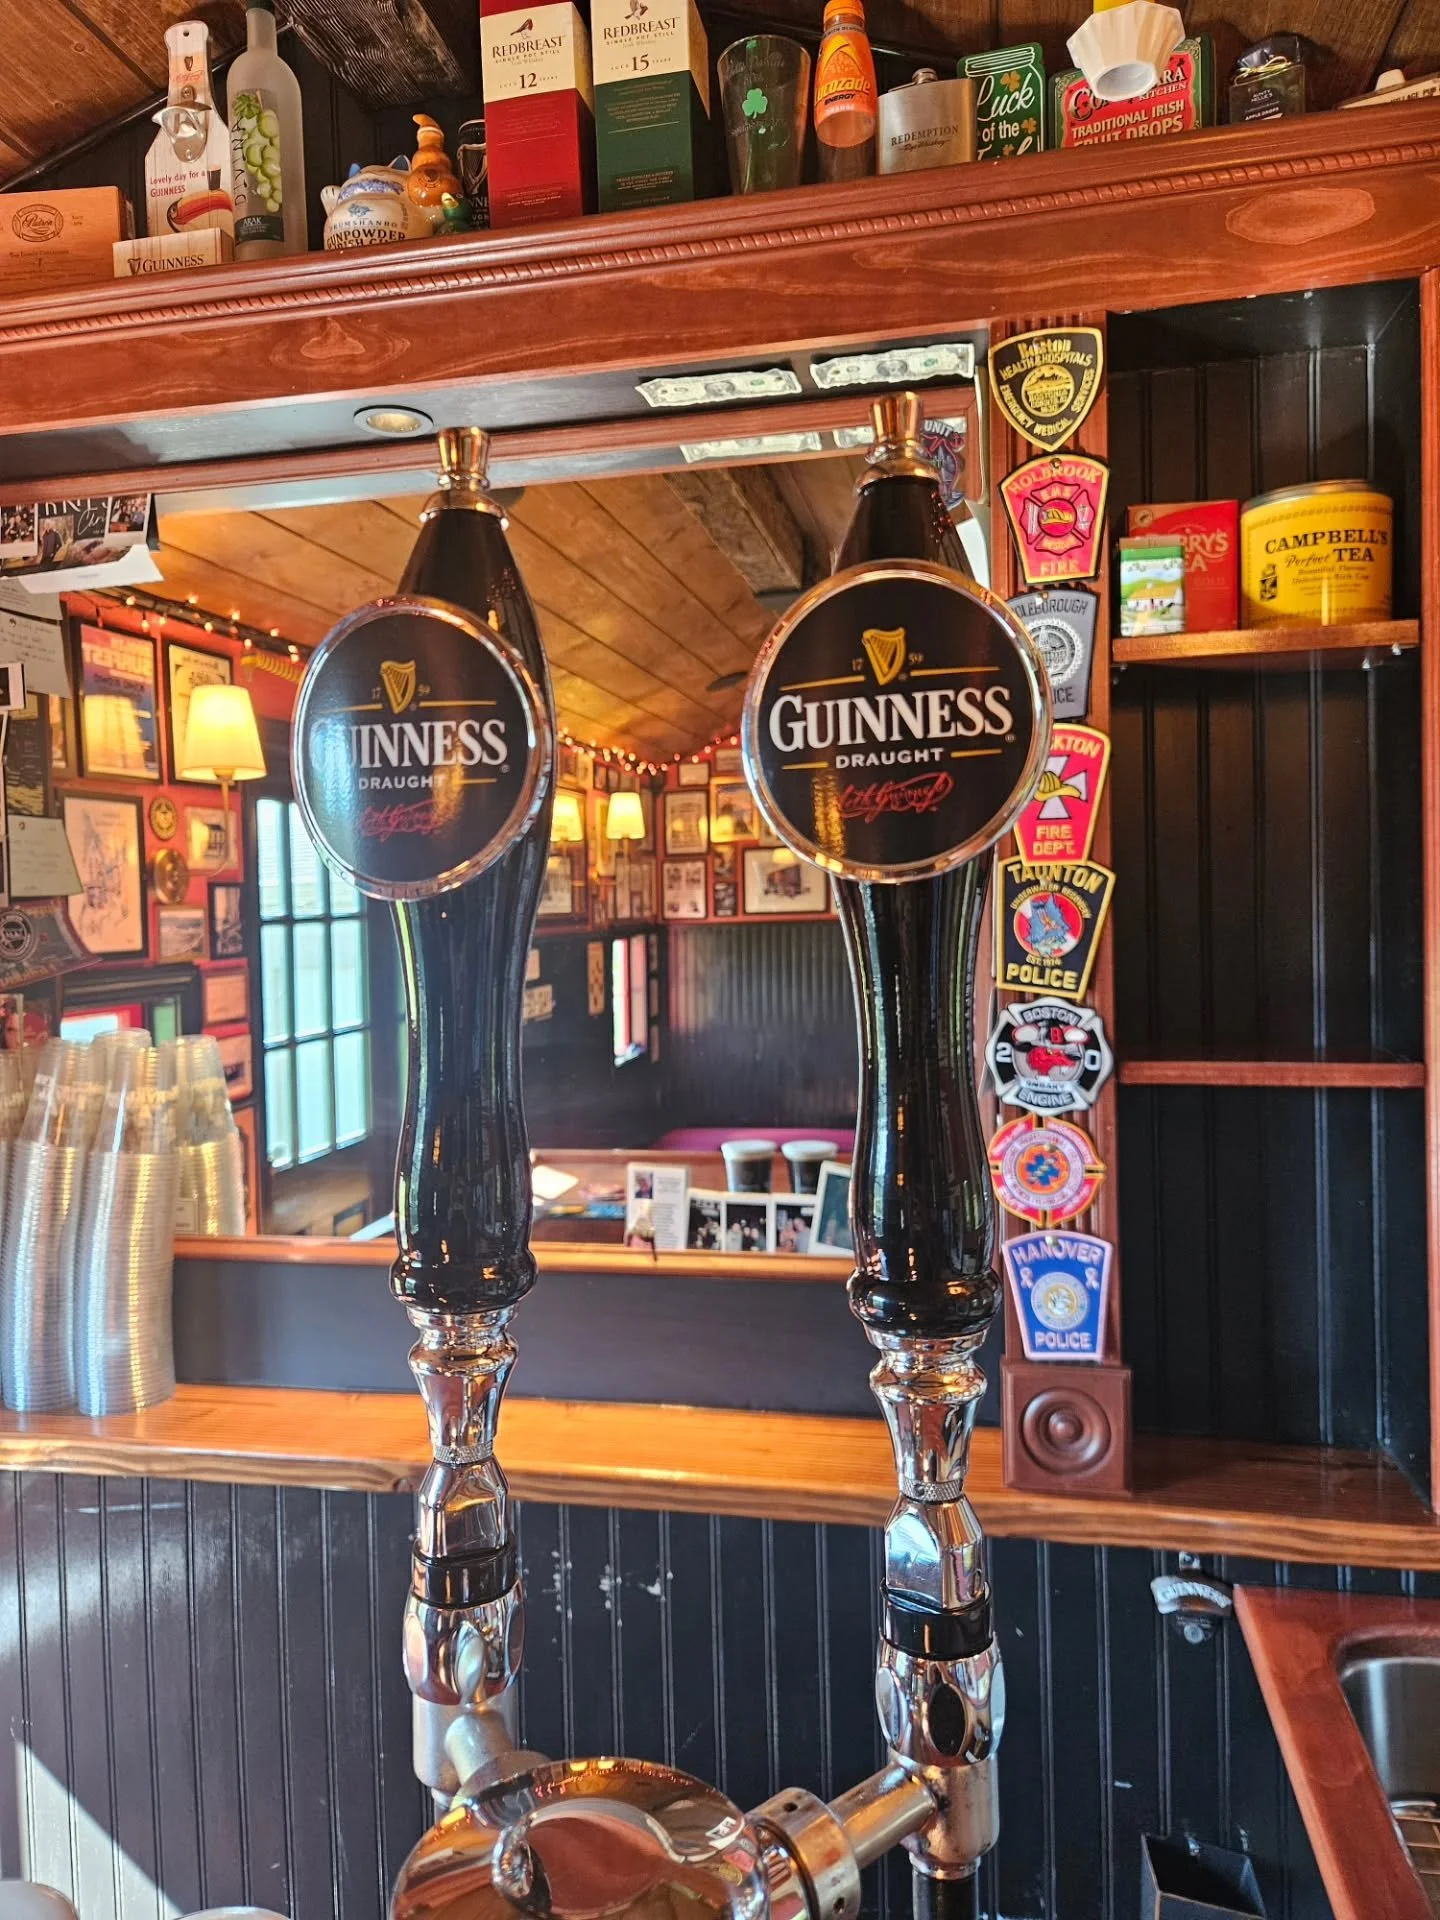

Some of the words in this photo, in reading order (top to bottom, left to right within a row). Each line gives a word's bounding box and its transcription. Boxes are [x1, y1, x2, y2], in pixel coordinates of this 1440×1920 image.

[603, 17, 678, 40] REDBREAST
[491, 35, 564, 59] REDBREAST
[632, 53, 650, 72] 15
[518, 72, 538, 90] 12
[815, 76, 871, 103] ucozade
[1138, 83, 1187, 101] KITCHEN
[824, 93, 857, 105] ENERGY
[976, 73, 1036, 121] Luck
[1072, 112, 1149, 140] TRADITIONAL
[1151, 99, 1185, 118] IRISH
[1073, 129, 1123, 147] UIT
[1125, 114, 1185, 140] DROPS
[890, 125, 959, 147] REDEMPTION
[982, 122, 996, 142] of
[998, 120, 1020, 138] the
[150, 173, 172, 185] Lovely
[174, 171, 187, 183] day
[189, 170, 200, 179] for
[150, 184, 186, 198] GUINNESS
[327, 228, 406, 250] GUNPOWDER
[142, 253, 205, 273] GUINNESS
[1000, 357, 1035, 381] HEALTH
[1040, 350, 1094, 367] HOSPITALS
[1000, 384, 1035, 428] EMERGENCY
[924, 419, 953, 438] UNIT
[1033, 417, 1073, 437] MEDICAL
[1008, 464, 1103, 495] HOLBROOK
[1179, 528, 1230, 553] RRY'S
[1265, 528, 1389, 555] CAMPBELL'S
[1040, 559, 1080, 577] FIRE
[1184, 552, 1208, 573] EA
[1285, 552, 1331, 569] Perfect
[1332, 547, 1376, 562] TEA
[1012, 598, 1089, 618] DLEBOROUGH
[1052, 686, 1075, 705] ICE
[769, 686, 1014, 753] GUINNESS
[1049, 733, 1102, 758] KTON
[835, 747, 945, 769] DRAUGHT
[358, 774, 446, 790] DRAUGHT
[1036, 824, 1072, 841] FIRE
[1007, 864, 1104, 894] TAUNTON
[1009, 883, 1061, 910] UNDERWATER
[1006, 963, 1079, 989] POLICE
[1022, 1007, 1079, 1025] BOSTON
[996, 1042, 1012, 1063] 2
[1084, 1048, 1101, 1071] 0
[1018, 1088, 1073, 1107] ENGINE
[1012, 1238, 1104, 1267] HANOVER
[1034, 1331, 1092, 1351] POLICE
